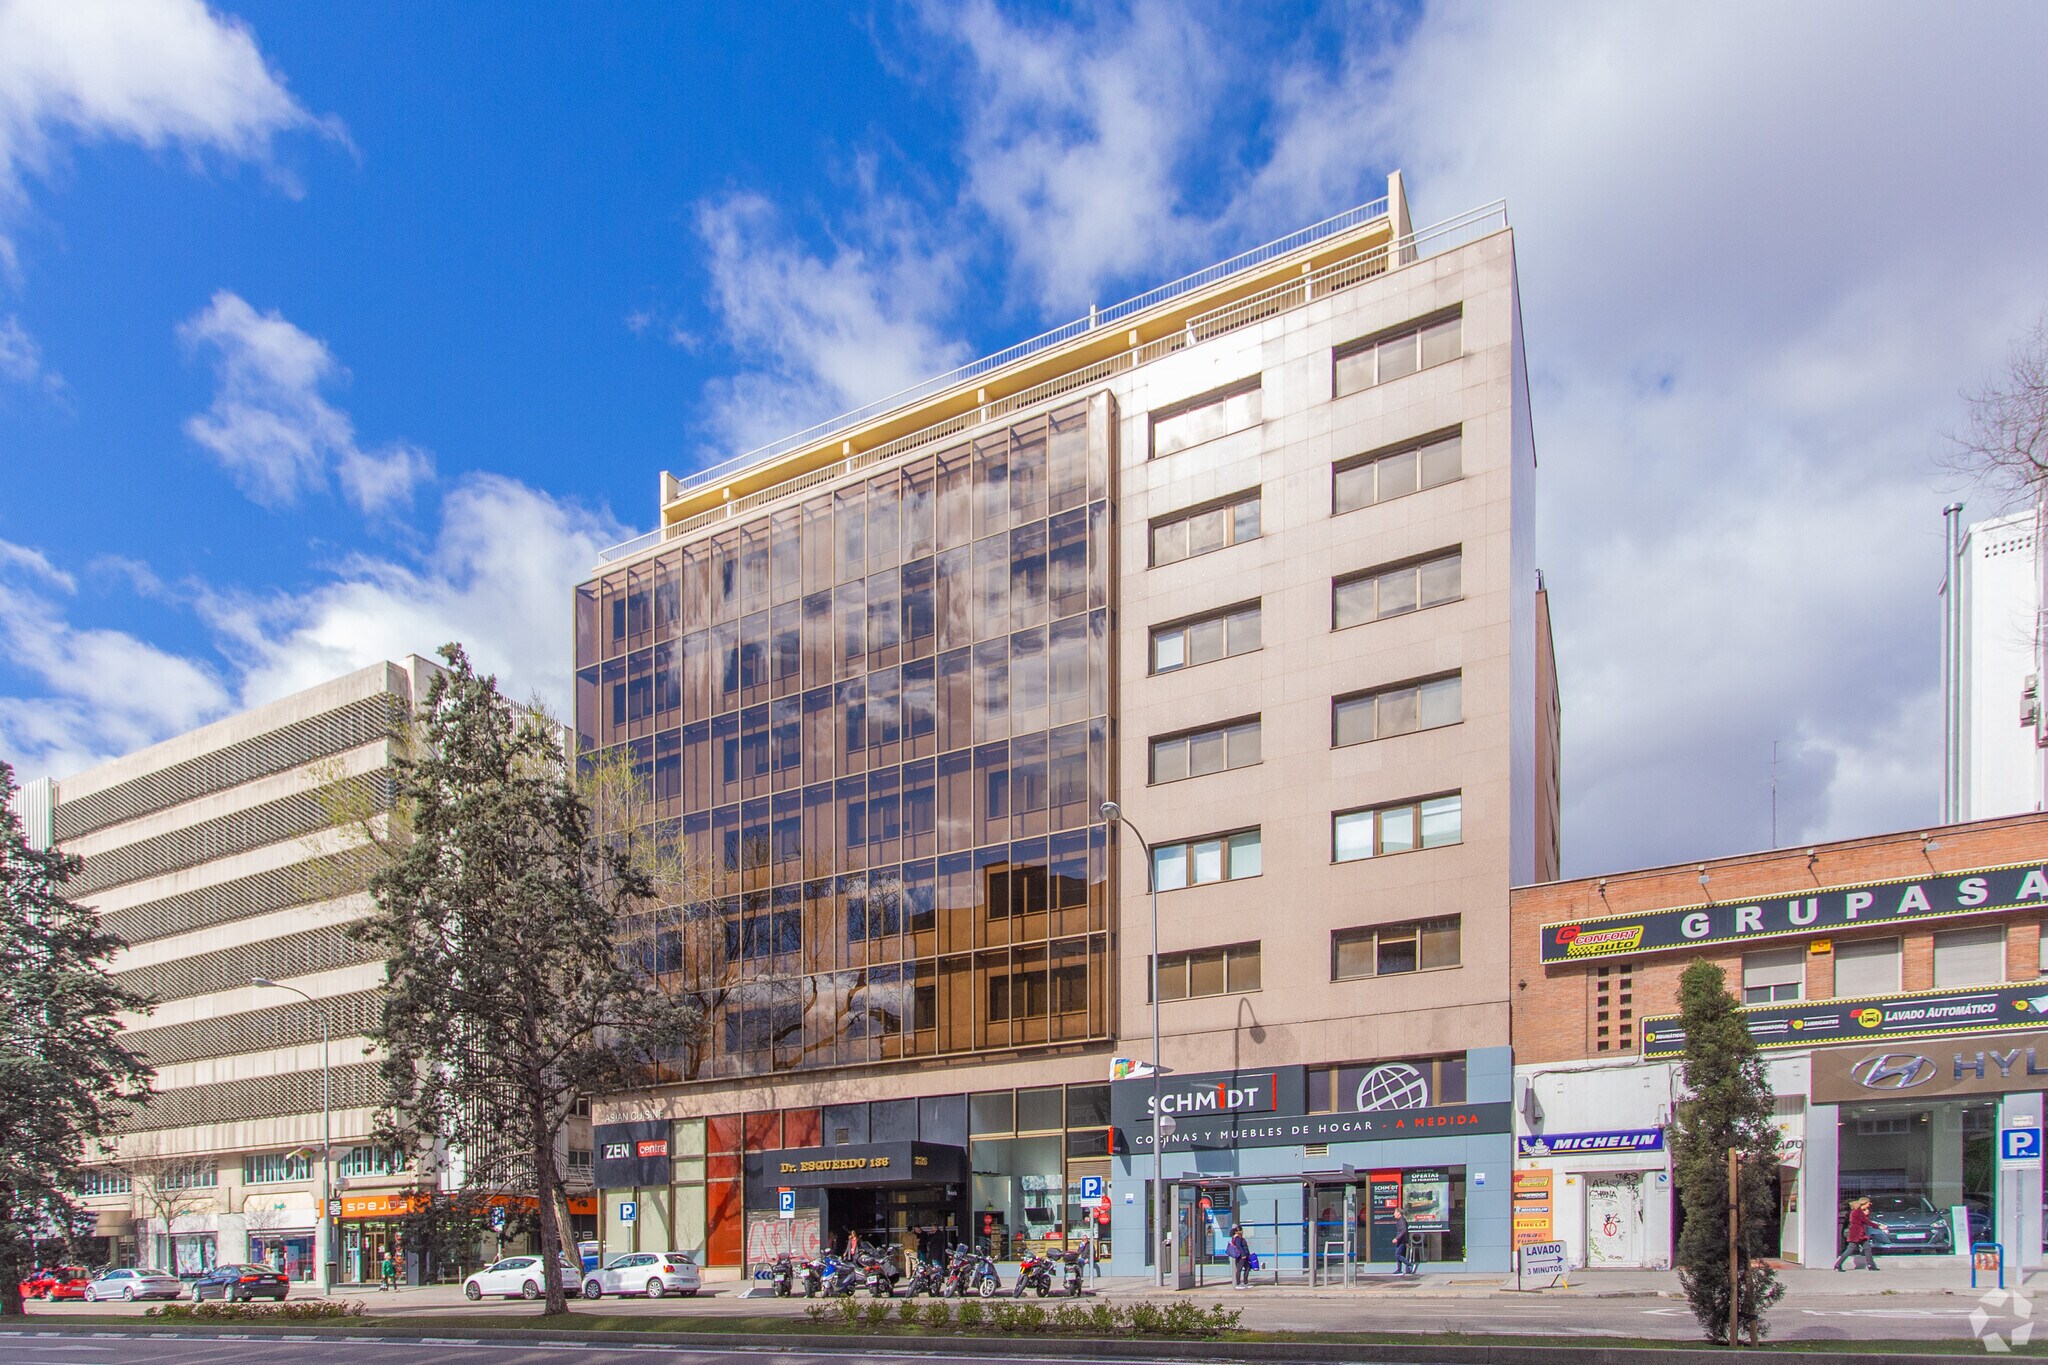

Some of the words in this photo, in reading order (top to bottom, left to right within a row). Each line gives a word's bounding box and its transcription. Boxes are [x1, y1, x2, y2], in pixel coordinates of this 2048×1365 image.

[1681, 870, 2048, 939] GRUPASA
[1574, 929, 1638, 945] CONFORT
[1595, 941, 1633, 952] auto
[1884, 1008, 1926, 1022] LAVADO
[1926, 1003, 1996, 1018] AUTOMÁTICO
[605, 1112, 629, 1123] ASIAN
[630, 1109, 664, 1121] CUISINE
[1204, 1131, 1212, 1141] Y
[1220, 1127, 1282, 1140] MUEBLES
[1291, 1125, 1309, 1135] DE
[1318, 1121, 1373, 1134] HOGAR
[1396, 1119, 1405, 1129] A
[1415, 1114, 1479, 1128] MEDIDA
[606, 1143, 630, 1159] ZEN
[639, 1141, 667, 1154] central
[1553, 1134, 1657, 1150] MICHELIN
[2008, 1132, 2033, 1156] P
[780, 1163, 797, 1173] Dr.
[800, 1158, 866, 1172] ESQUERDO
[1084, 1179, 1098, 1197] P
[782, 1194, 793, 1210] P
[622, 1204, 633, 1219] P
[1526, 1244, 1561, 1256] LAVADO
[1533, 1265, 1563, 1275] MINUTOS
